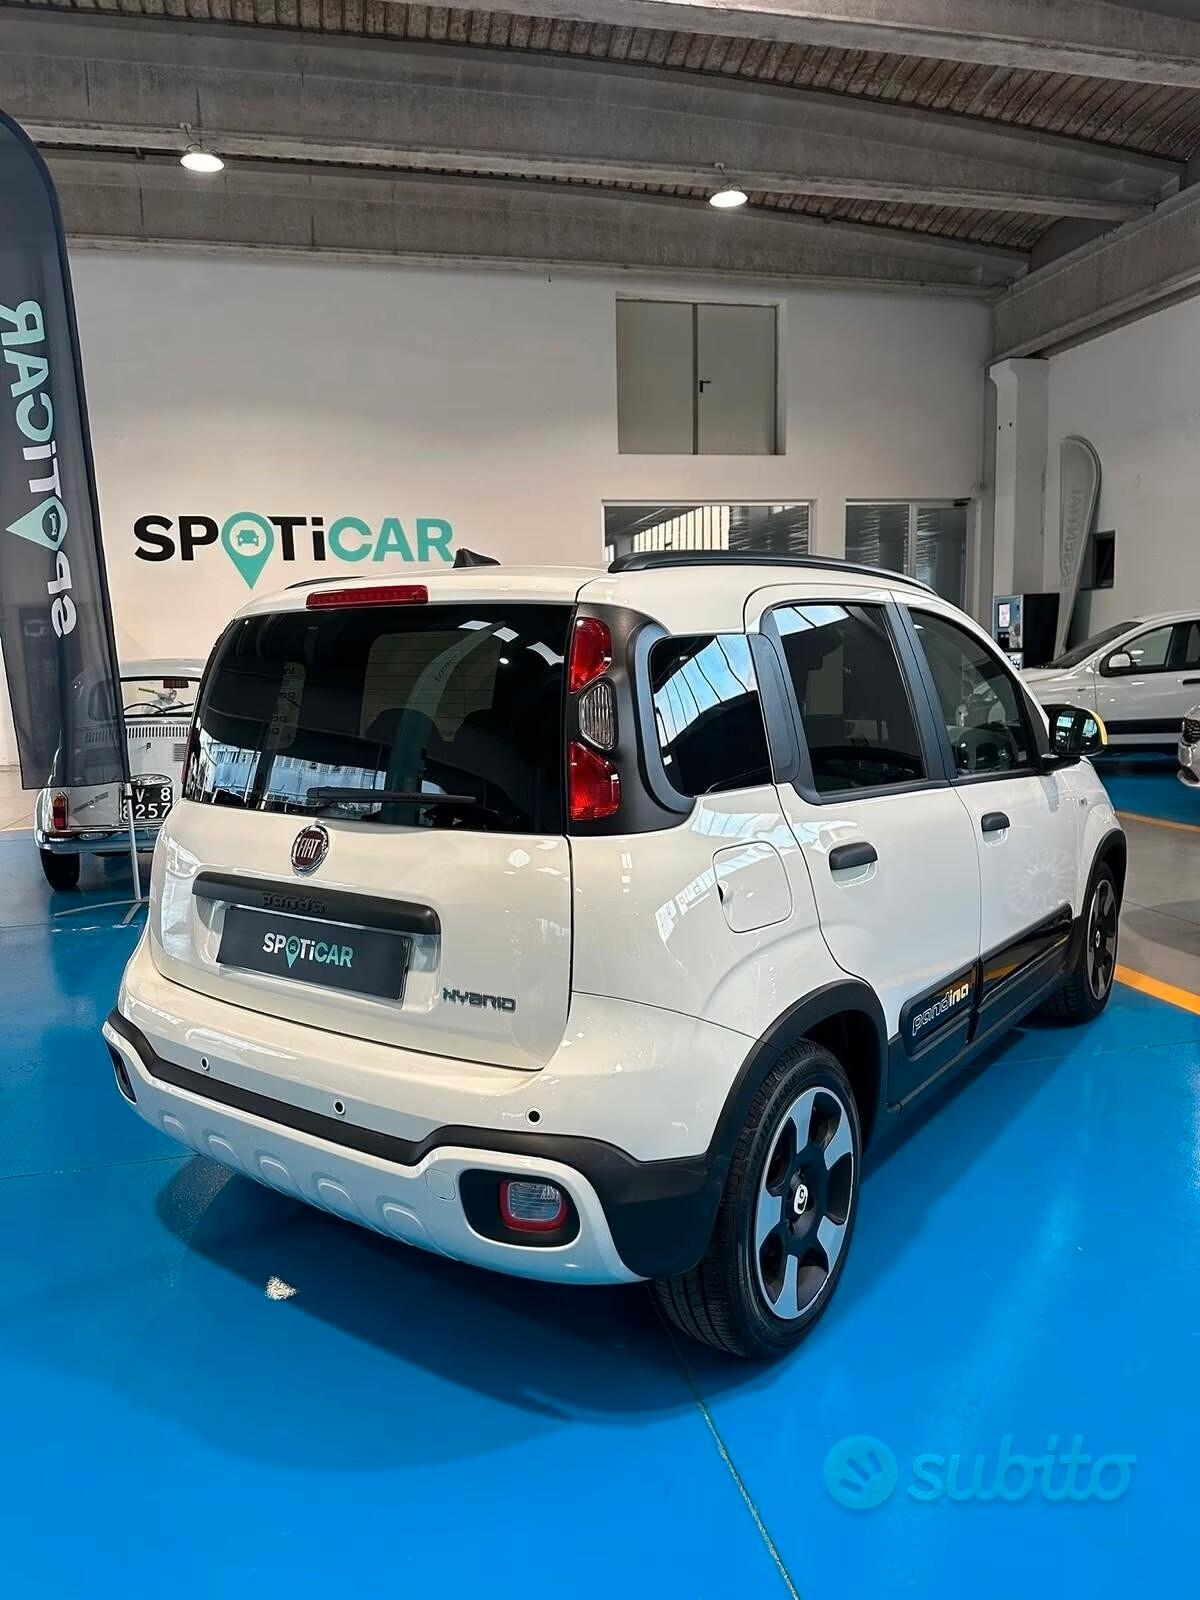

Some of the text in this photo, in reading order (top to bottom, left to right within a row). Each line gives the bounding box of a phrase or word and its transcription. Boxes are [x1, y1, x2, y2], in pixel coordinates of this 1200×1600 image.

[160, 787, 171, 801] 8
[296, 837, 321, 859] FIAT
[442, 987, 516, 1012] HYBRID
[911, 983, 969, 1037] pandina
